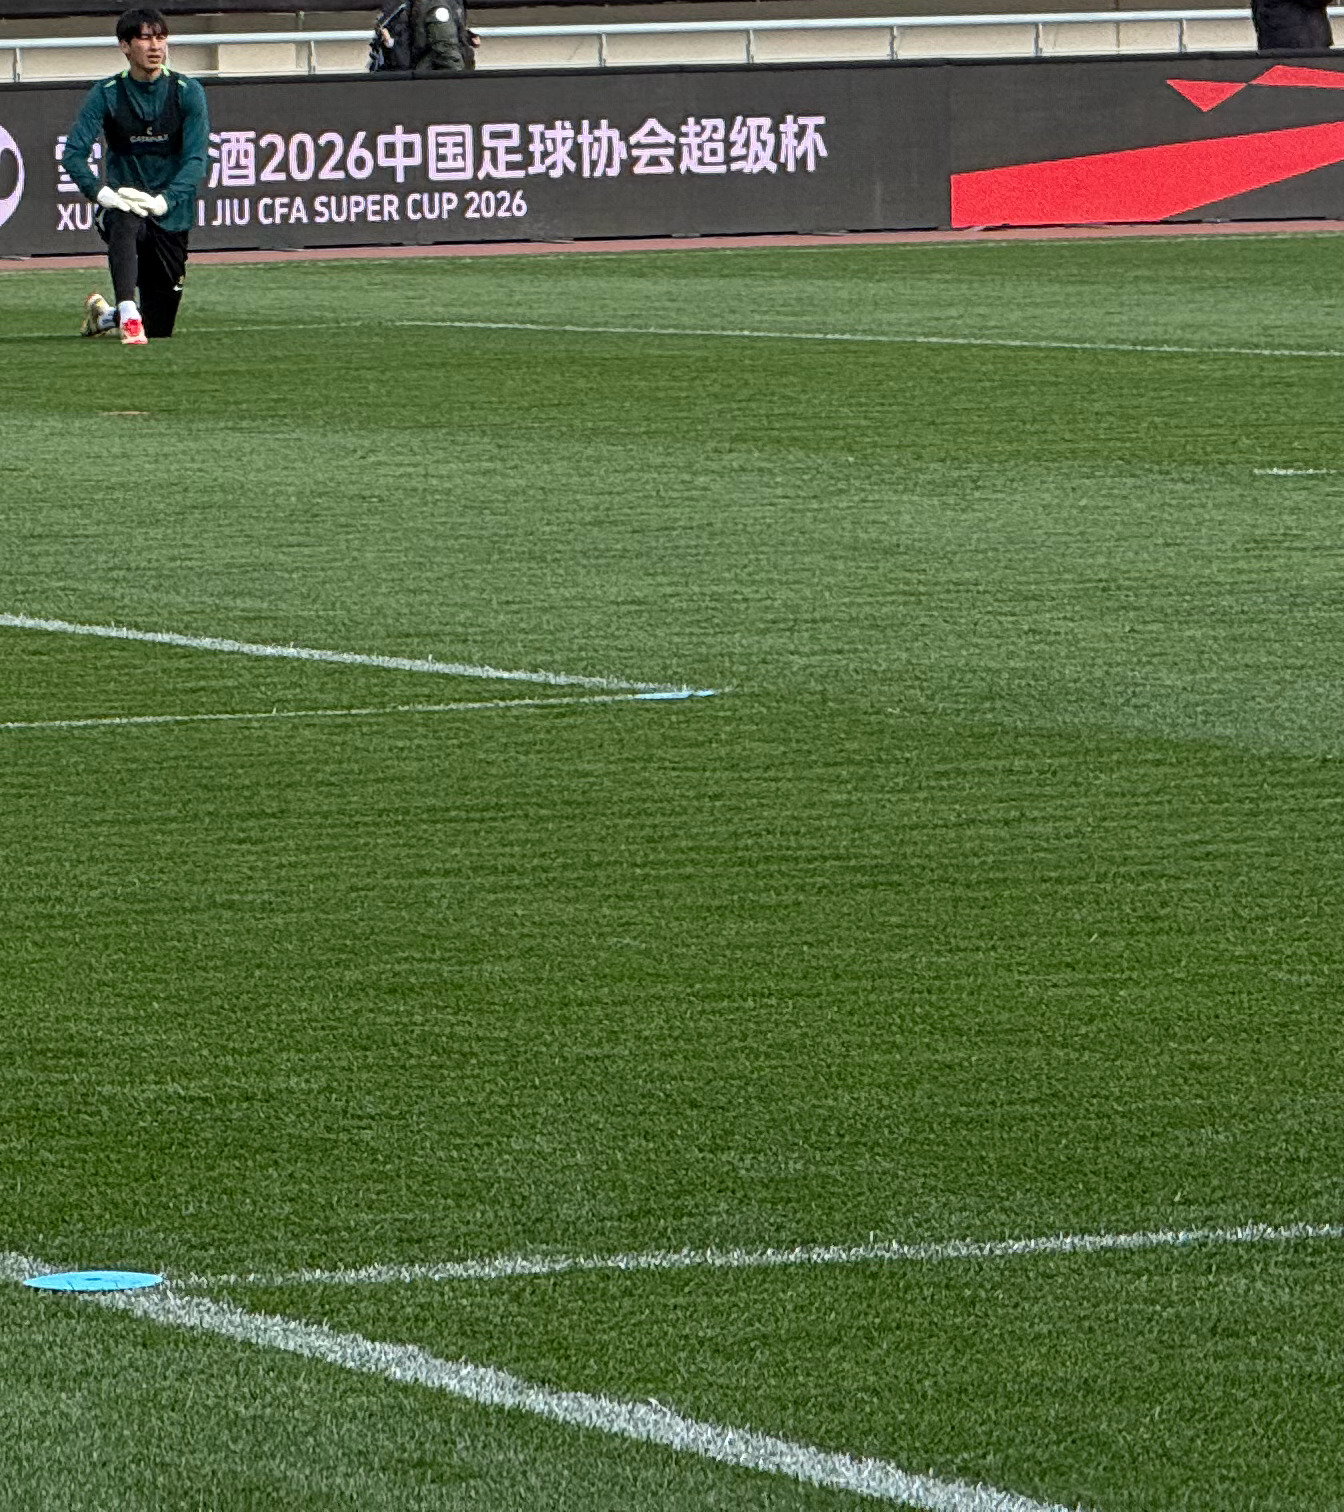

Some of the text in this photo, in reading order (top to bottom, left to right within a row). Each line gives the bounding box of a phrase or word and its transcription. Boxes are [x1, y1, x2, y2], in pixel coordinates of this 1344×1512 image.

[56, 202, 96, 231] XU
[211, 198, 251, 226] JIU
[258, 196, 309, 225] CFA
[313, 193, 401, 223] SUPER
[406, 191, 459, 220] CUP
[464, 189, 528, 219] 2026
